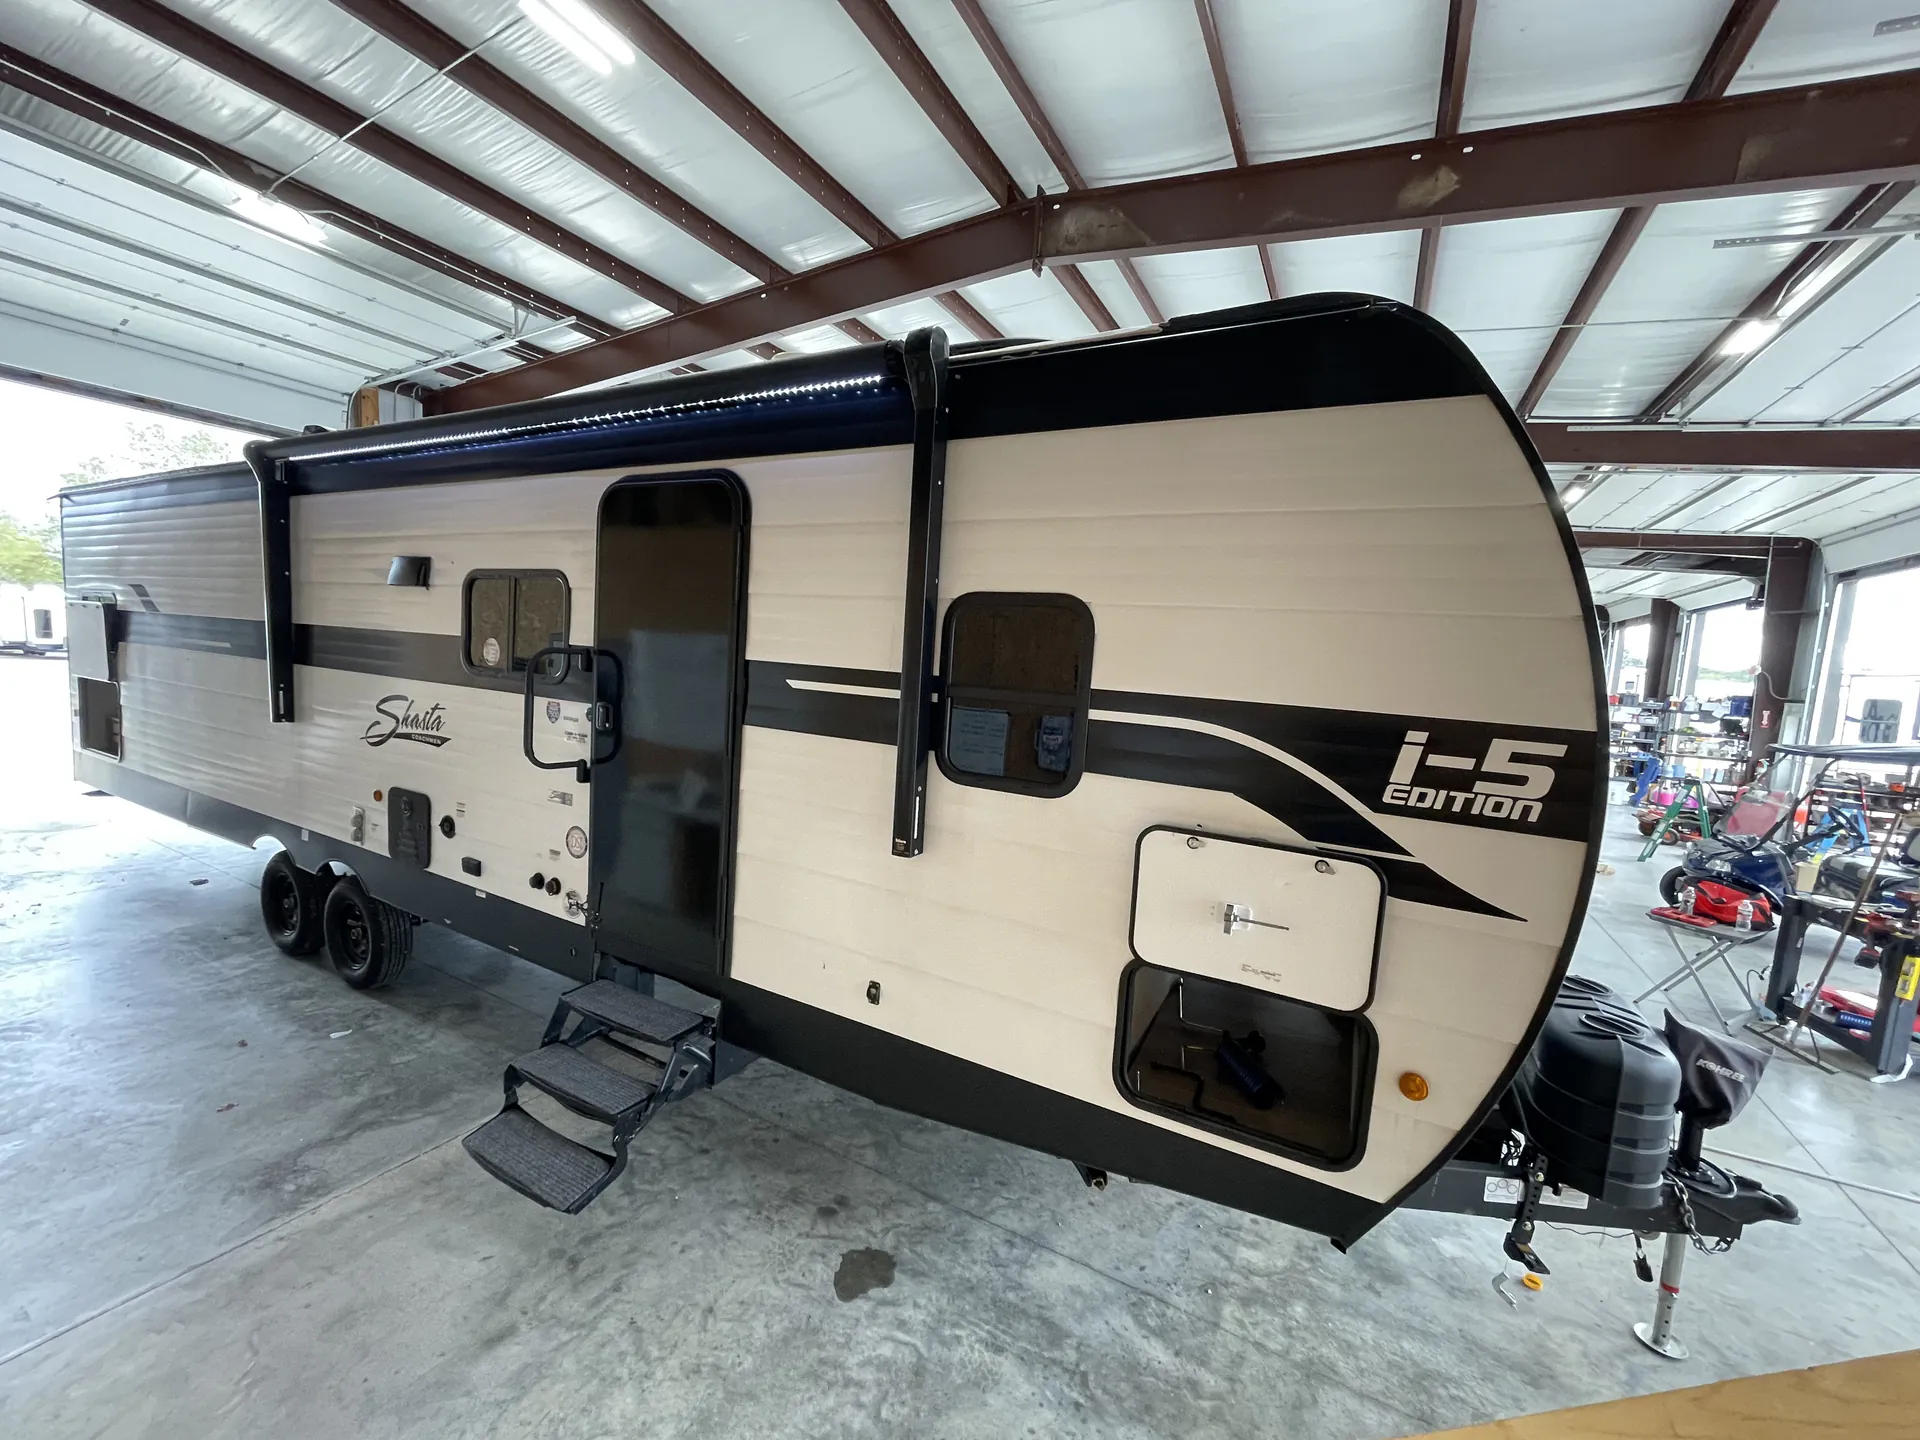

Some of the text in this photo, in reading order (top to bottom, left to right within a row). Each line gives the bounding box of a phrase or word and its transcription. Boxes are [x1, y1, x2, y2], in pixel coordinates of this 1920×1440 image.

[365, 694, 446, 747] Shasta
[411, 734, 442, 745] COACHMEN
[1389, 730, 1568, 799] i-5
[1382, 783, 1543, 823] EDITION
